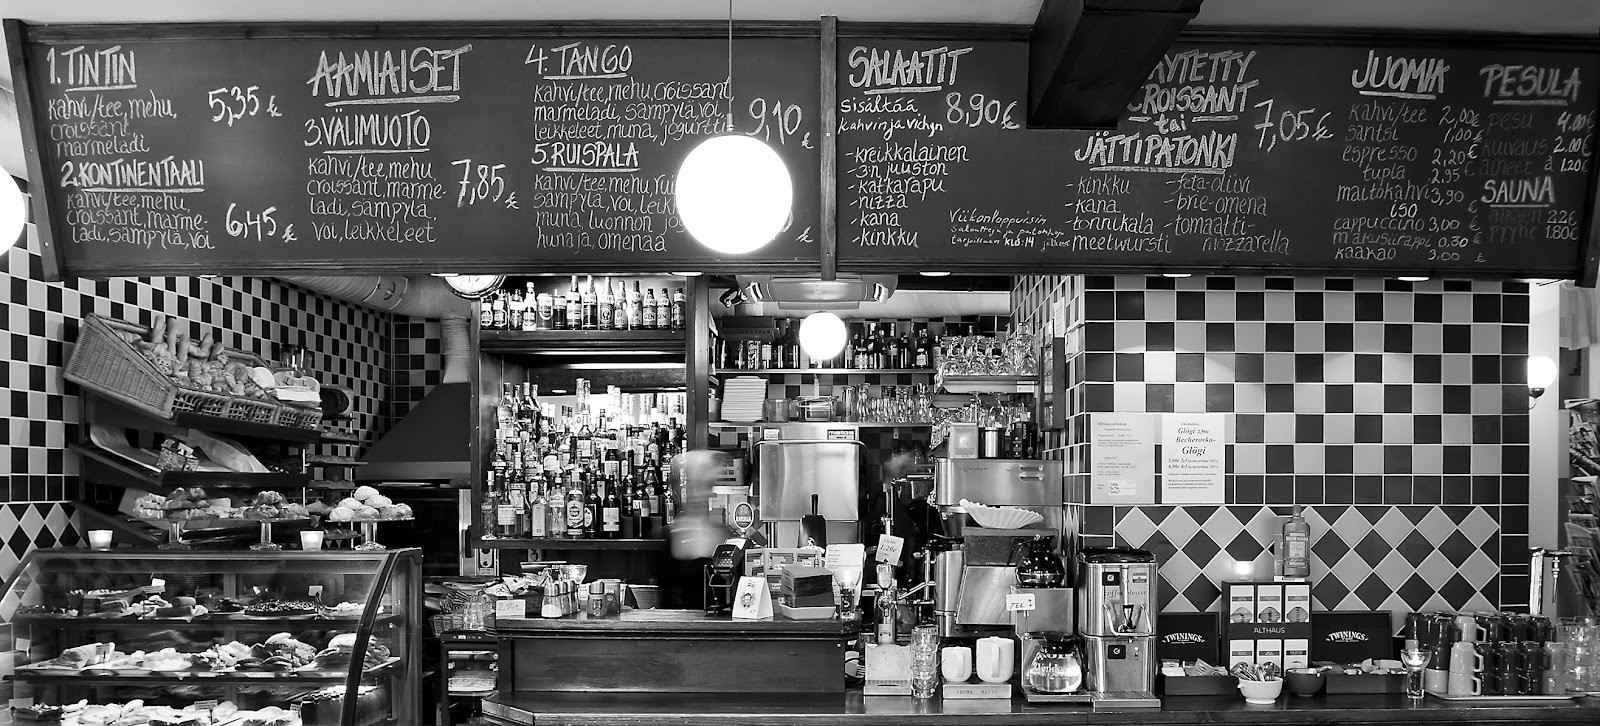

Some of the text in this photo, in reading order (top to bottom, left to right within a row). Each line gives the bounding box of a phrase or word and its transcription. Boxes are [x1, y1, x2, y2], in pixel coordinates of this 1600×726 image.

[550, 42, 632, 76] TANGO
[848, 46, 973, 88] SALAATIT
[306, 44, 473, 98] AAMIAISET
[1352, 50, 1450, 94] JUOMIA
[1480, 64, 1582, 102] PESULA
[1154, 114, 1187, 134] tai
[1487, 112, 1533, 134] pesu
[57, 135, 150, 157] marmeladi
[1342, 146, 1418, 167] espresso
[884, 162, 948, 182] juuston
[1363, 163, 1406, 186] tupla
[1481, 176, 1556, 204] SAUNA
[1390, 200, 1418, 218] iso
[589, 210, 653, 232] luonnon
[1334, 217, 1424, 232] cappuccino
[344, 221, 436, 244] leikkeleet
[598, 232, 668, 252] omenaa
[1072, 233, 1172, 253] meetwursti
[1335, 246, 1396, 260] kaakao
[1182, 446, 1206, 456] Glögi
[1164, 632, 1203, 643] TWININGS
[1328, 630, 1366, 642] TWININGS
